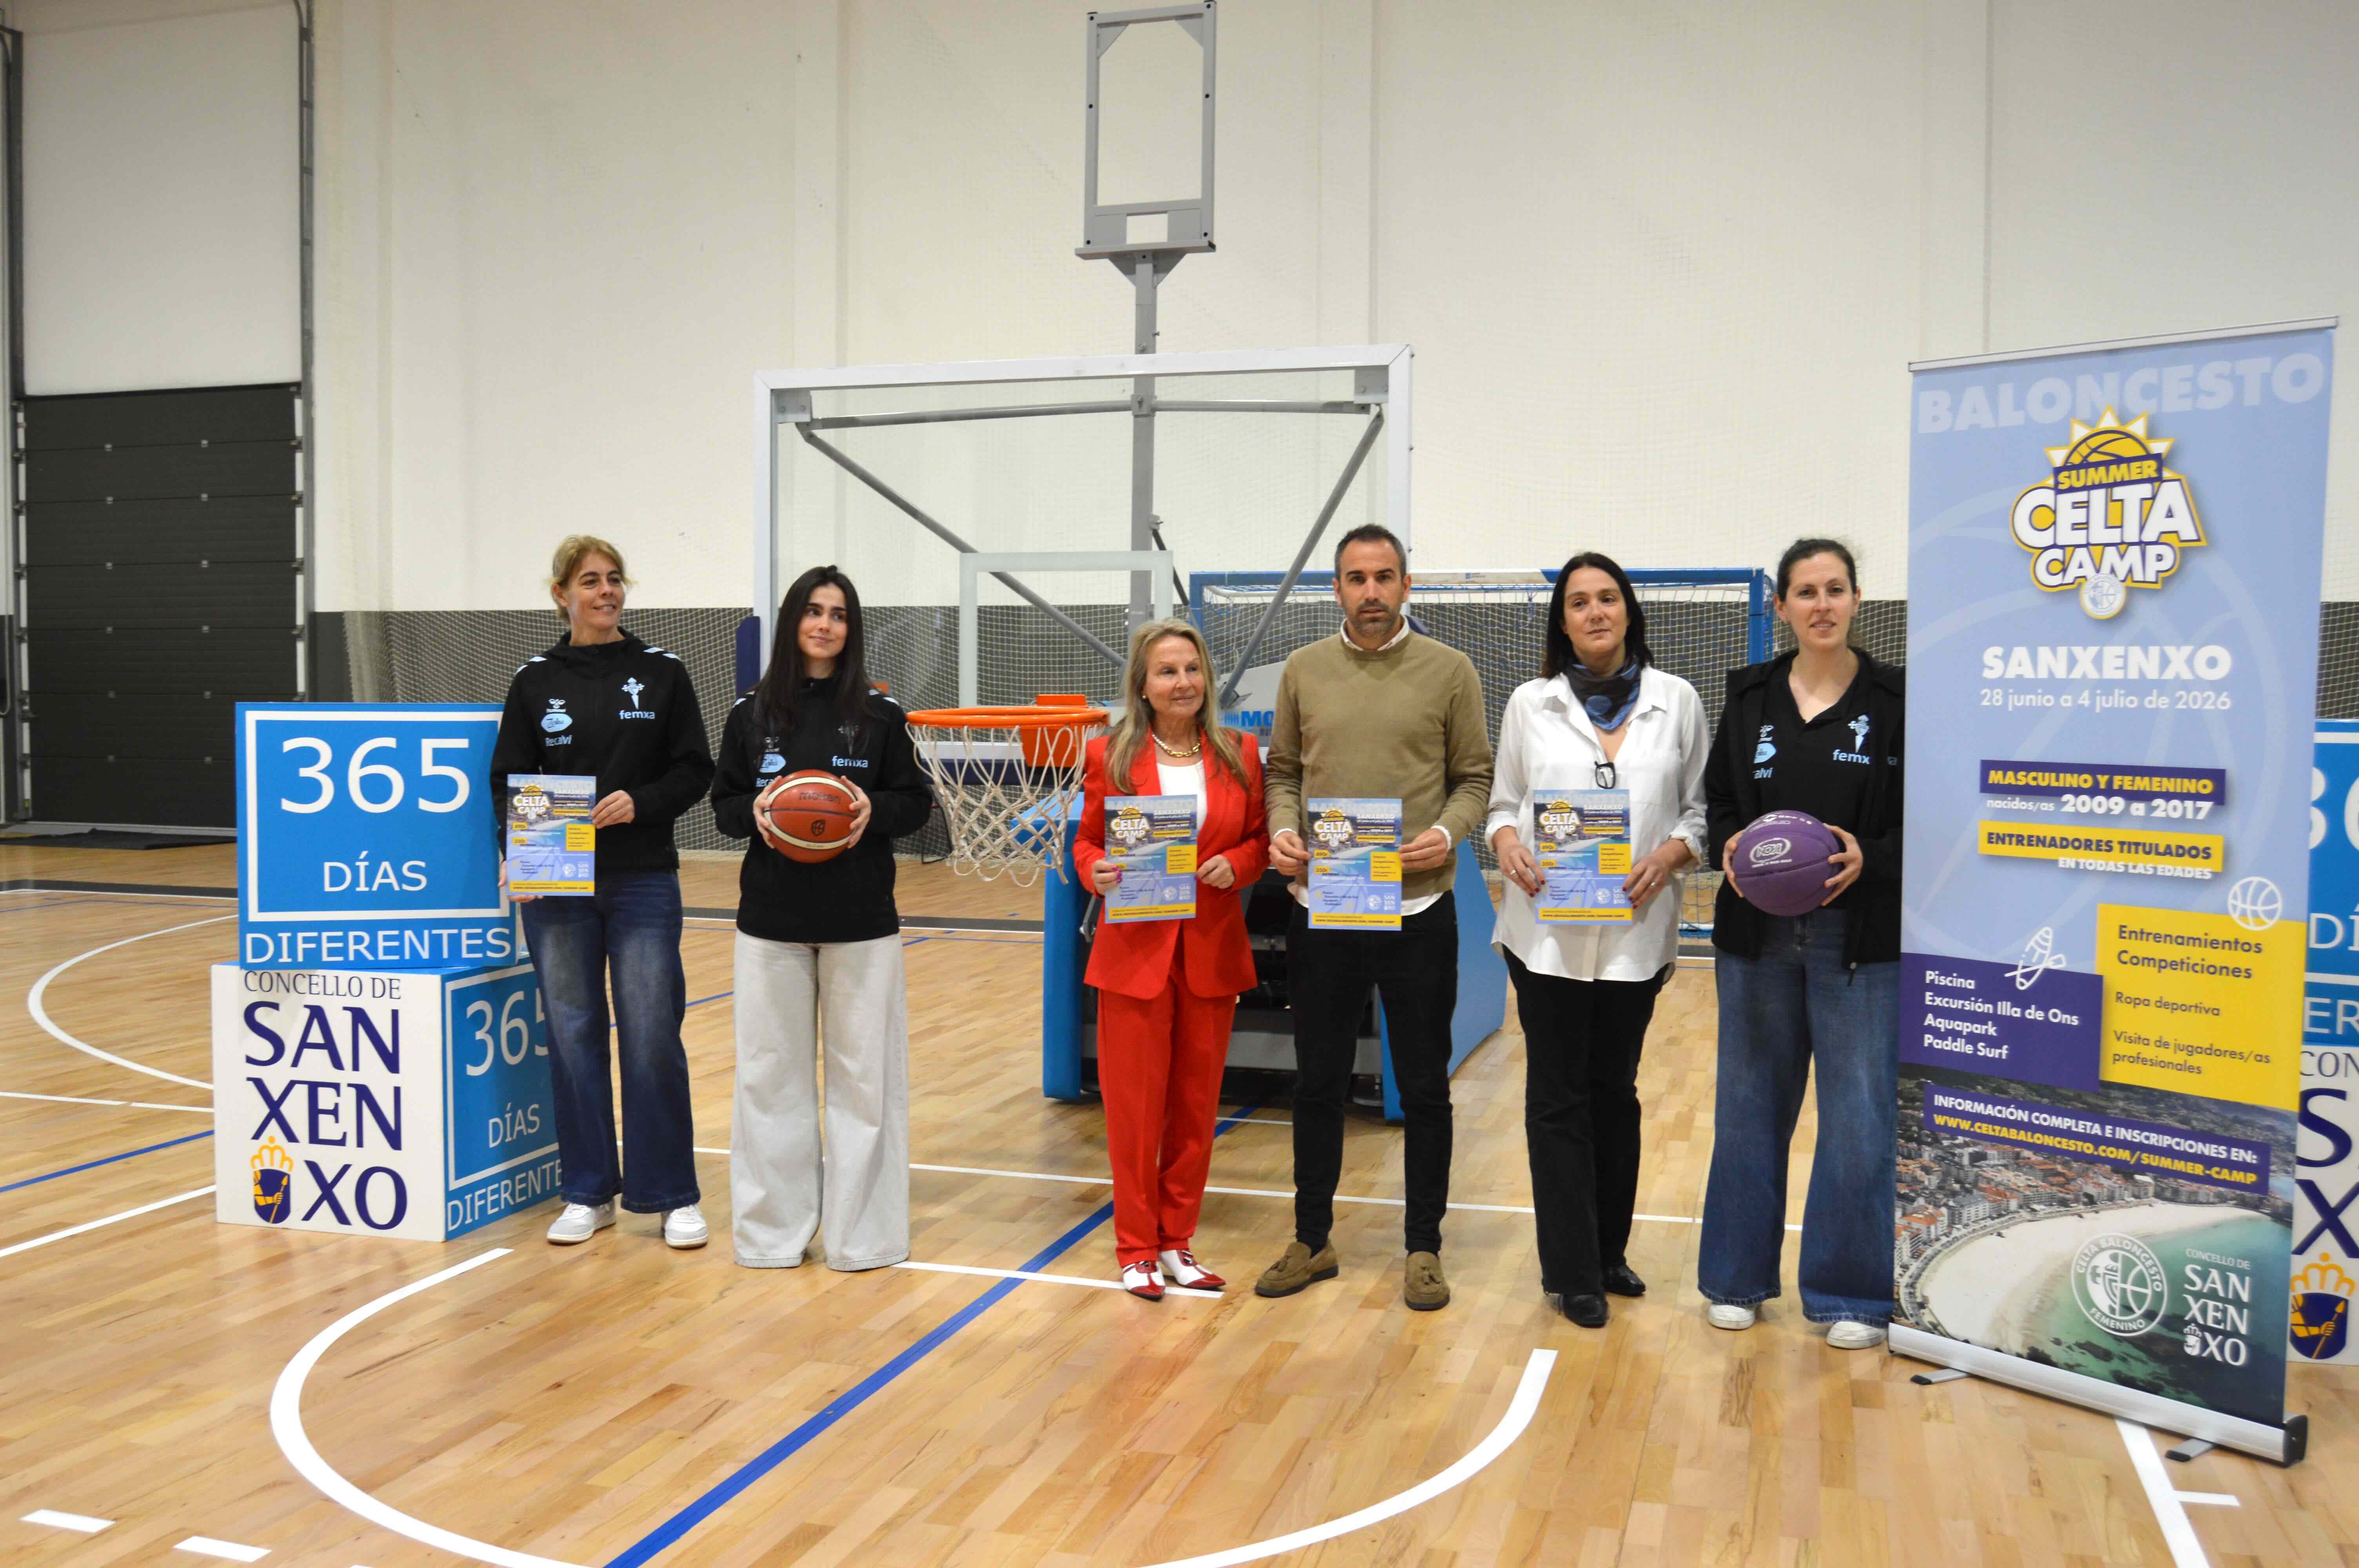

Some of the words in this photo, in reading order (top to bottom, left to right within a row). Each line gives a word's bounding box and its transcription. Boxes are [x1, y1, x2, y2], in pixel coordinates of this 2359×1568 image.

[1918, 352, 2324, 434] BALONCESTO
[2058, 460, 2157, 489] SUMMER
[2013, 480, 2200, 548] CELTA
[2035, 544, 2175, 587] CAMP
[1982, 645, 2232, 681] SANXENXO
[619, 710, 655, 719] femxa
[1980, 689, 2003, 706] 28
[2008, 689, 2054, 711] junio
[2060, 694, 2072, 706] a
[2077, 690, 2090, 706] 4
[2095, 689, 2138, 712] julio
[2144, 690, 2169, 708] de
[2175, 691, 2231, 710] 2026
[832, 756, 868, 768] femxa
[1832, 749, 1870, 764] femx
[281, 737, 470, 813] 365
[1752, 768, 1773, 779] alvi
[1988, 770, 2093, 788] MASCULINO
[2096, 775, 2110, 789] Y
[2113, 775, 2214, 794] FEMENINO
[513, 795, 550, 806] CELTA
[1986, 797, 2055, 811] nacidos/as
[2059, 794, 2125, 815] 2009
[2130, 802, 2146, 816] a
[2150, 799, 2214, 819] 2017
[1111, 818, 1149, 830] CELTA
[1314, 821, 1353, 833] CELTA
[1539, 812, 1581, 825] CELTA
[1987, 832, 2114, 852] ENTRENADORES
[2118, 840, 2212, 860] TITULADOS
[323, 851, 427, 891] DÍAS
[2058, 857, 2076, 868] EN
[2079, 858, 2125, 872] TODAS
[2128, 863, 2154, 875] LAS
[2157, 864, 2212, 879] EDADES
[246, 928, 511, 964] DIFERENTES
[2119, 925, 2262, 953] Entrenamientos
[2118, 950, 2252, 979] Competiciones
[244, 971, 362, 998] CONCELLO
[372, 978, 401, 999] DE
[1925, 970, 1975, 989] Piscina
[1925, 992, 1993, 1013] Excursión
[1997, 1001, 2021, 1018] Illa
[2025, 1005, 2044, 1020] de
[2048, 1009, 2079, 1025] Ons
[2116, 992, 2150, 1008] Ropa
[2155, 996, 2221, 1016] deportiva
[244, 1001, 400, 1074] SAN
[1924, 1013, 1997, 1036] Aquapark
[1924, 1034, 1973, 1054] Paddle
[1977, 1042, 2008, 1059] Surf
[2114, 1030, 2150, 1046] Visita
[2154, 1036, 2170, 1049] de
[2174, 1039, 2270, 1063] jugadores/as
[2113, 1052, 2202, 1074] profesionales
[246, 1077, 402, 1151] XEN
[489, 1103, 540, 1148] DÍAS
[1934, 1095, 2029, 1122] INFORMACIÓN
[2031, 1112, 2102, 1135] COMPLETA
[2105, 1125, 2113, 1137] E
[2116, 1127, 2227, 1158] INSCRIPCIONES
[2231, 1148, 2258, 1163] EN:
[1934, 1114, 2257, 1184] WWW.CELTABALONCESTO.COM/SUMMER-CAMP
[301, 1160, 407, 1230] XO
[447, 1158, 562, 1232] DIFERENTE
[2077, 1241, 2099, 1273] CELTA
[2100, 1236, 2162, 1292] BALONCESTO
[2186, 1248, 2234, 1266] CONCELLO
[2237, 1259, 2250, 1270] DE
[2184, 1264, 2250, 1302] SAN
[2089, 1308, 2146, 1331] FEMENINO
[2183, 1294, 2247, 1334] XEN
[2202, 1333, 2247, 1366] XO
